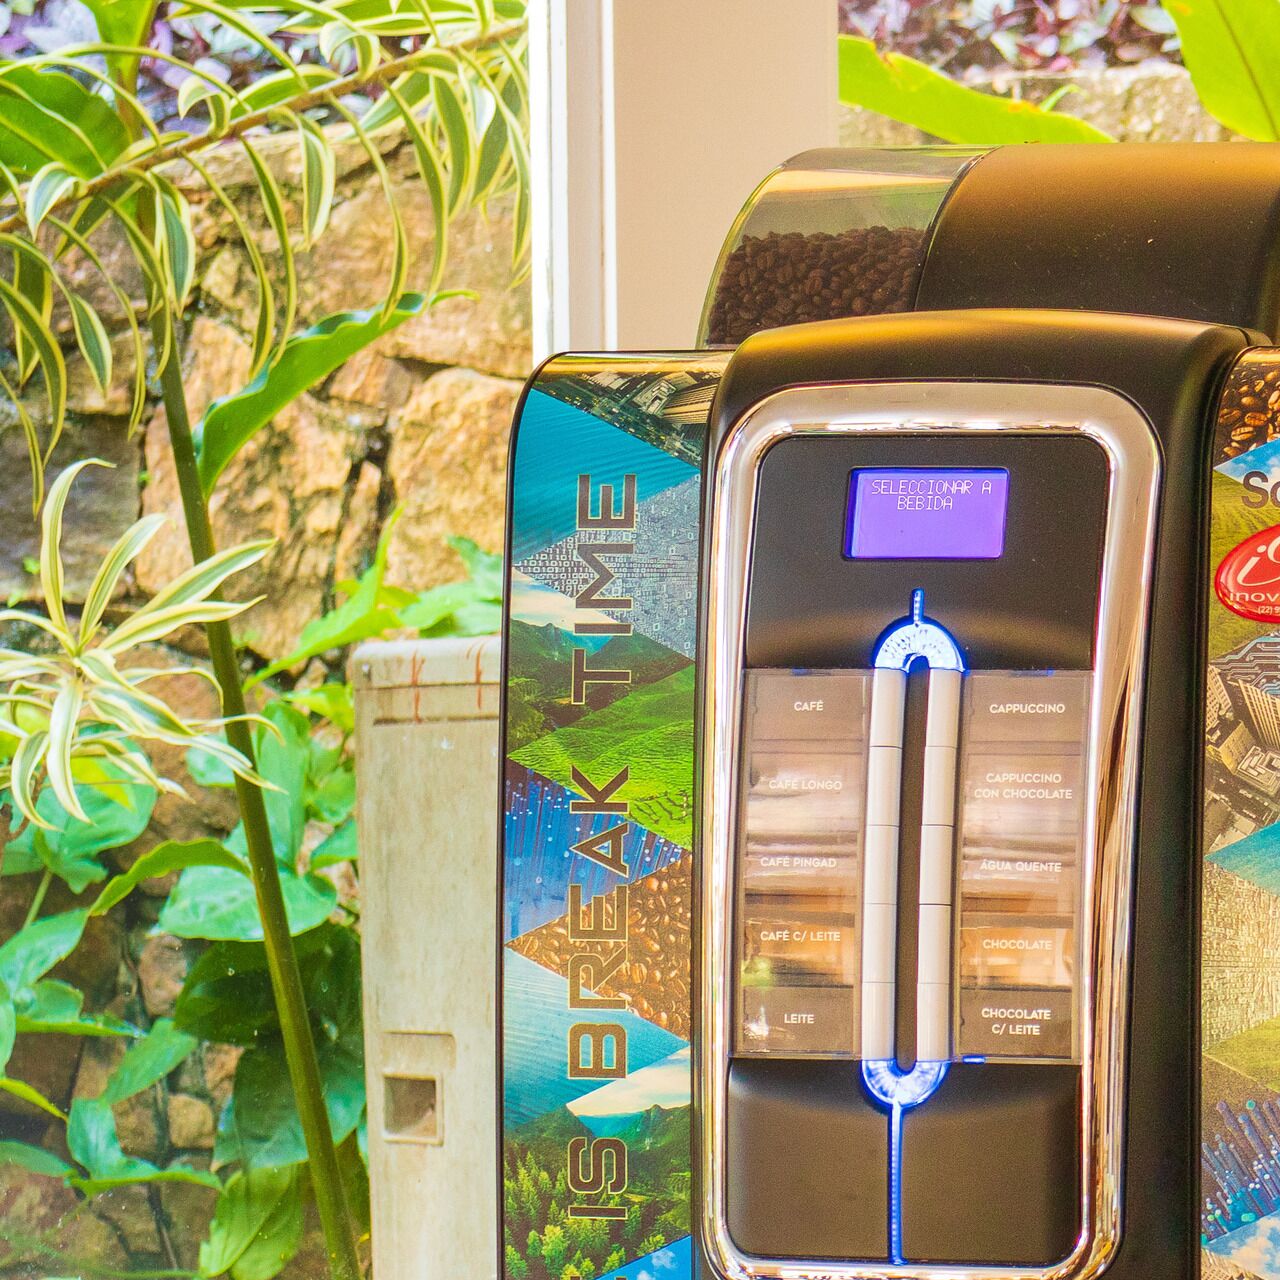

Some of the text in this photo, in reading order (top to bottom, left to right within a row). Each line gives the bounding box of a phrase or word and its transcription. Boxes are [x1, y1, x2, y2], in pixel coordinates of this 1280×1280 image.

[871, 479, 992, 495] SELECCIONAR A
[897, 496, 953, 511] BEBIDA
[571, 473, 637, 706] TIME
[1258, 605, 1273, 615] (22)
[793, 699, 824, 712] CAFÉ
[989, 703, 1066, 714] CAPPUCCINO
[768, 777, 842, 791] CAFÉ LONGO
[985, 772, 1062, 784] CAPPUCCINO
[974, 788, 1073, 800] CON CHOCOLATE
[760, 855, 790, 868] CAFÉ
[979, 858, 1062, 873] ÁGUA QUENTE
[567, 764, 631, 1080] BREAK
[760, 929, 841, 943] CAFÉ C/ LEITE
[982, 938, 1053, 951] CHOCOLATE
[783, 1012, 815, 1025] LEITE
[981, 1007, 1052, 1020] CHOCOLATE
[991, 1023, 1041, 1037] C/ LEITE
[567, 1135, 630, 1220] IS
